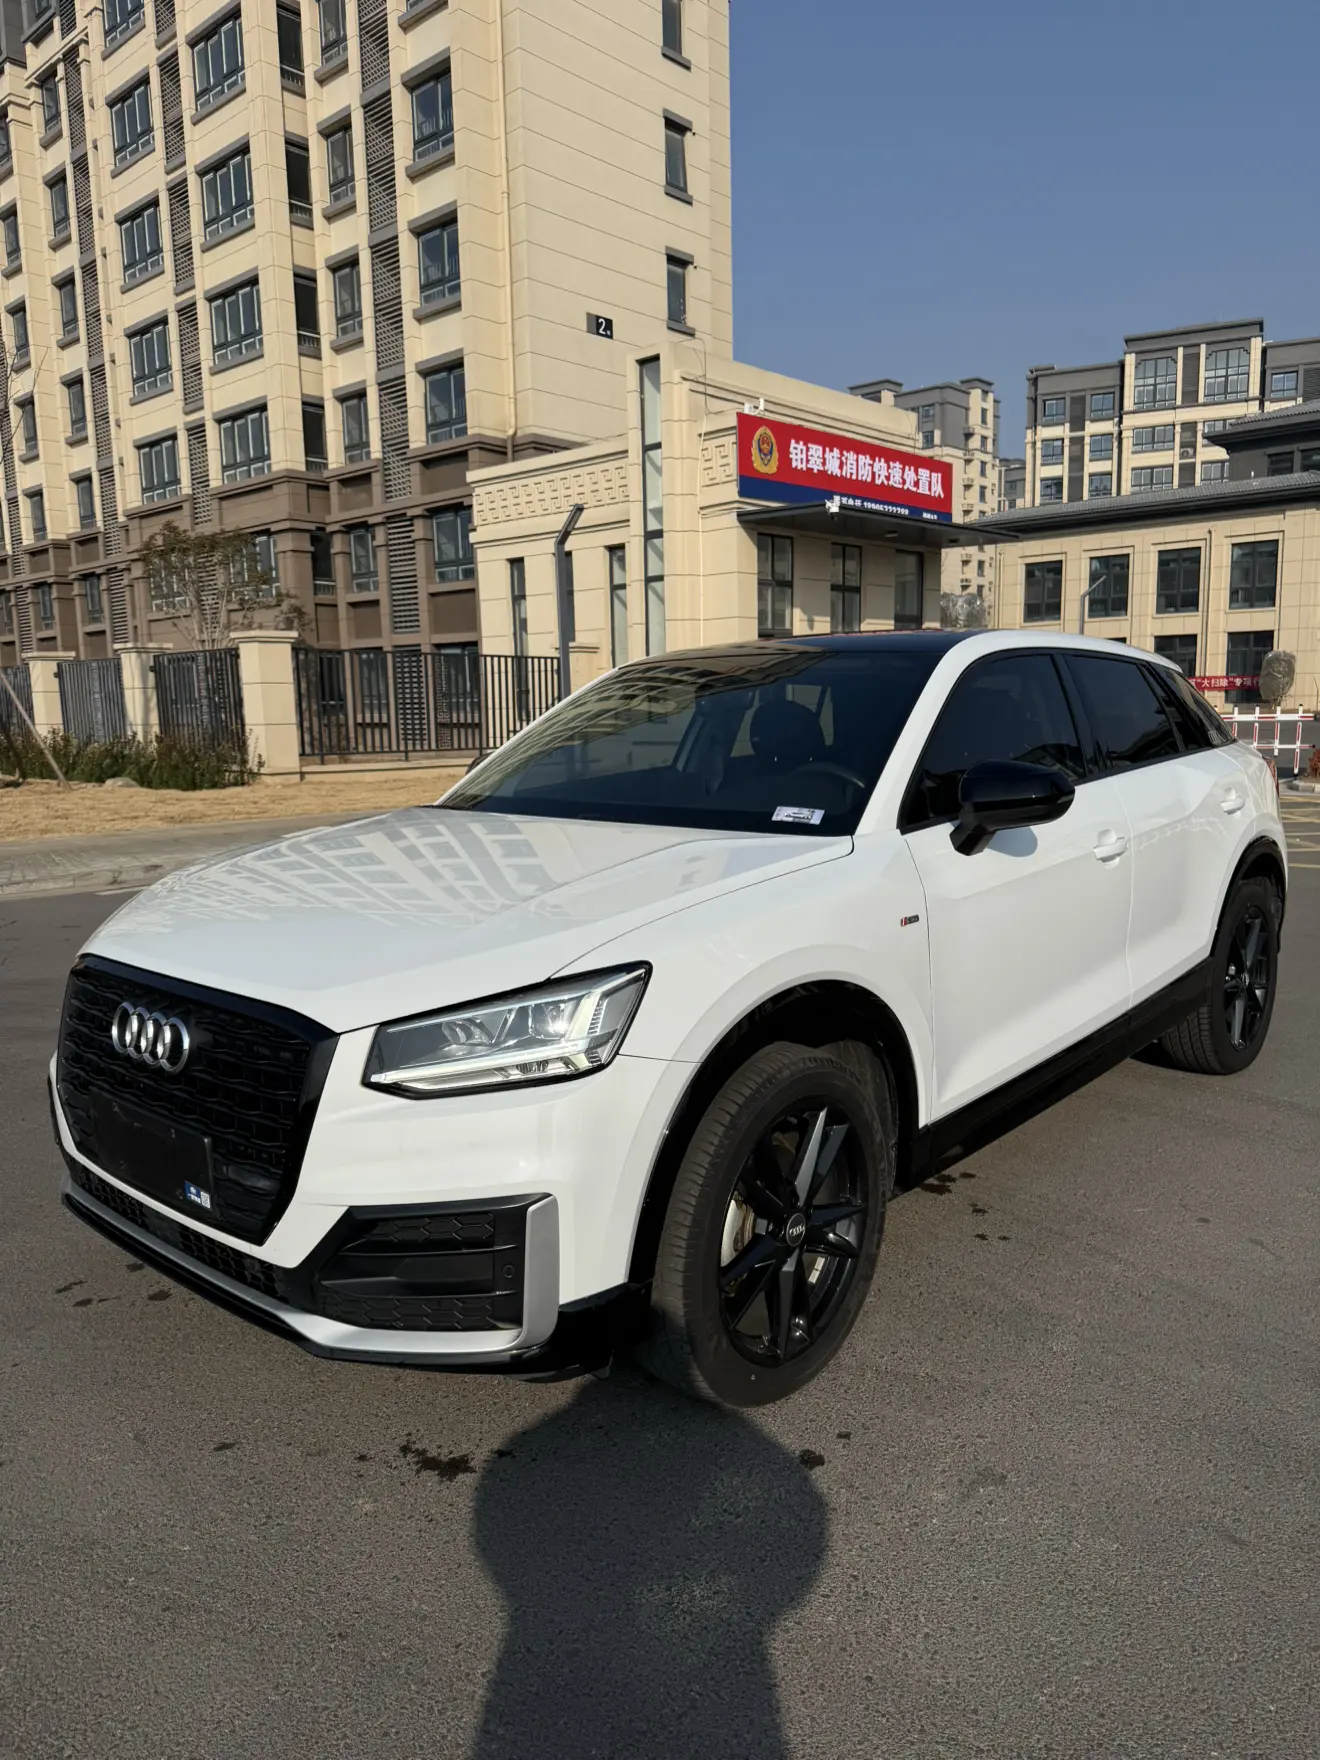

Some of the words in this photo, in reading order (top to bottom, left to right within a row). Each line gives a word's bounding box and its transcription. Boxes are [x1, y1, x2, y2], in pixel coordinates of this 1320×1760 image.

[789, 438, 945, 499] 铂翠城消防快速处置队
